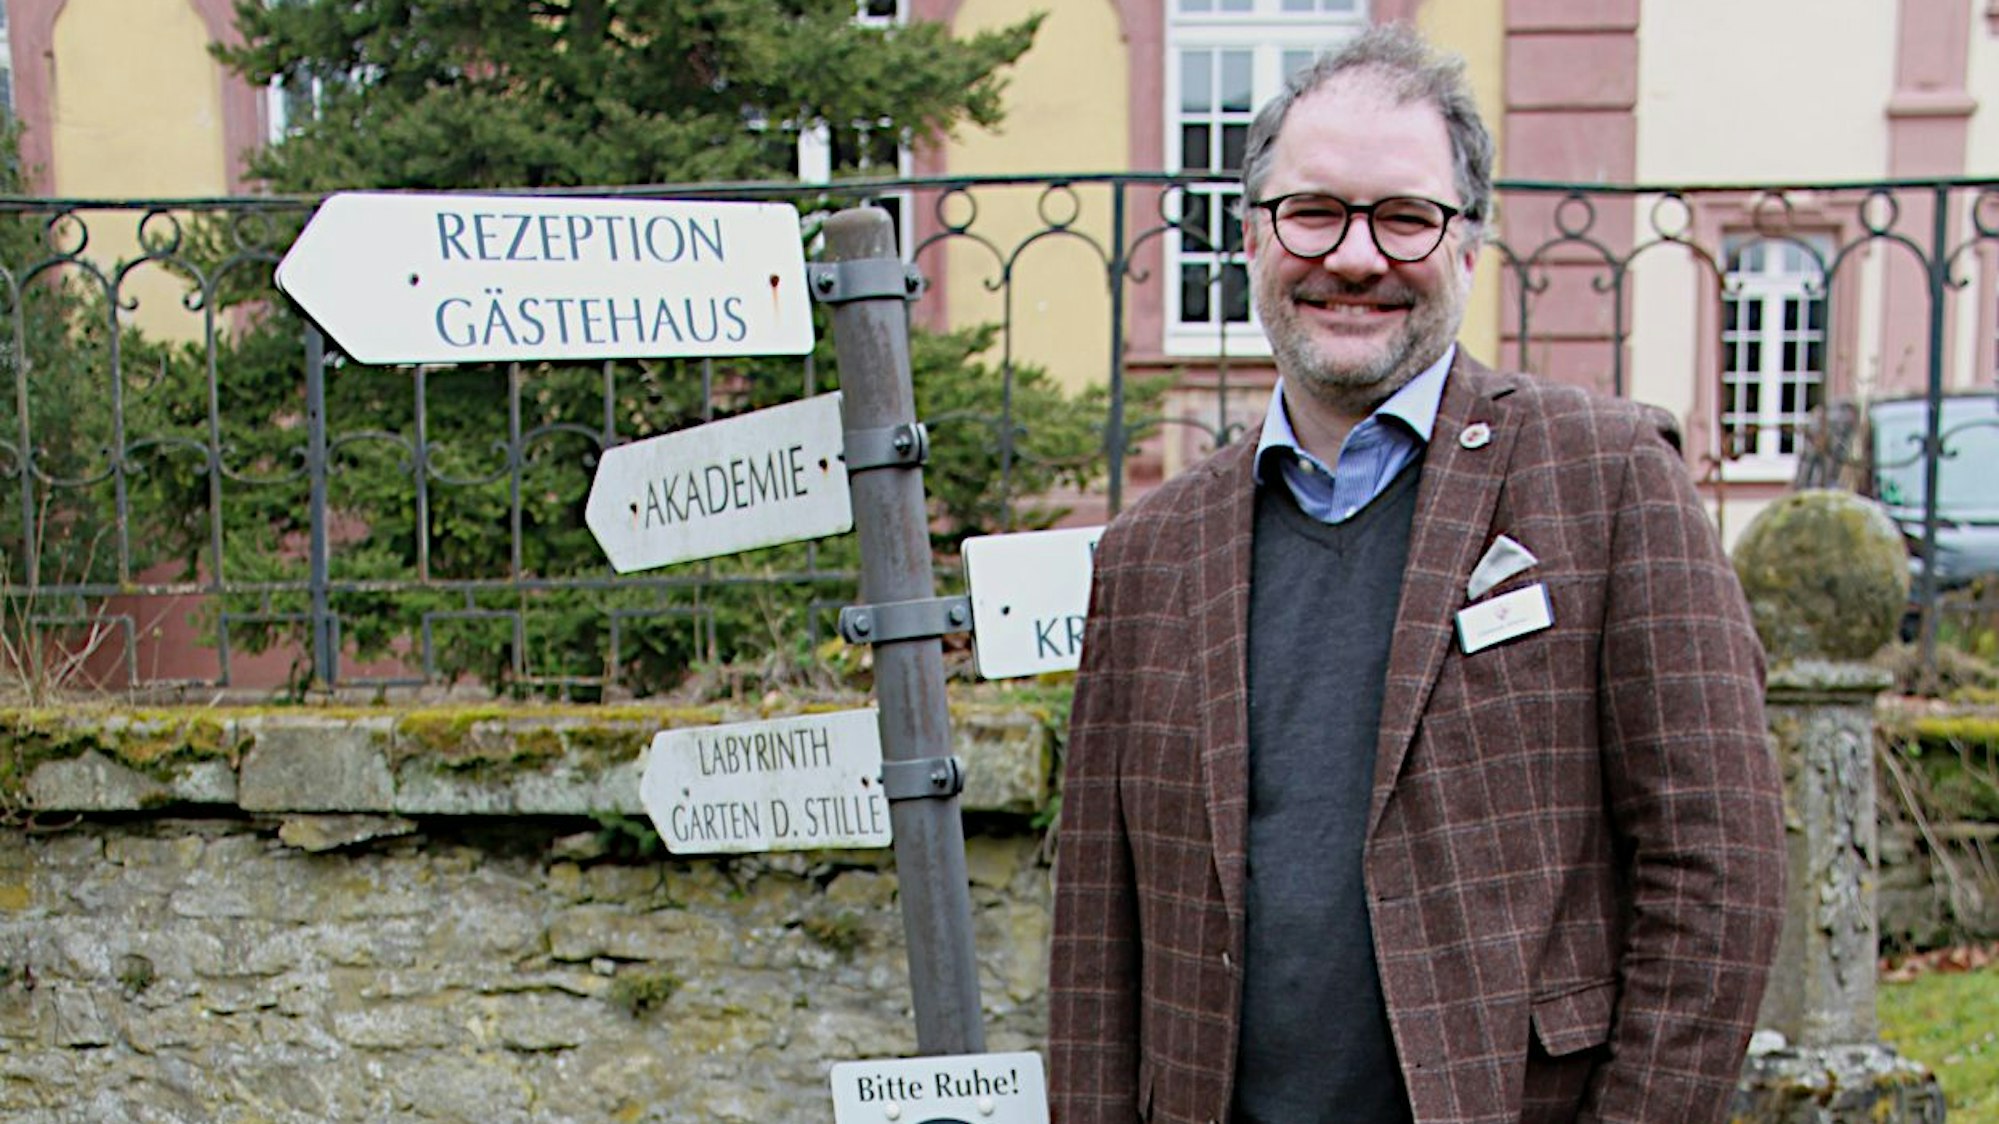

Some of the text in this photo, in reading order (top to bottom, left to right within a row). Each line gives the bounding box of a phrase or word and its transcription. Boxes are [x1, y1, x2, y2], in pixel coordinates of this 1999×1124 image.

[436, 212, 725, 263] REZEPTION
[435, 288, 748, 348] GÄSTEHAUS
[644, 445, 808, 528] AKADEMIE
[698, 727, 831, 776] LABYRINTH
[672, 795, 884, 842] GARTEN D. STILLE
[857, 1069, 1019, 1102] Bitte Ruhe!
